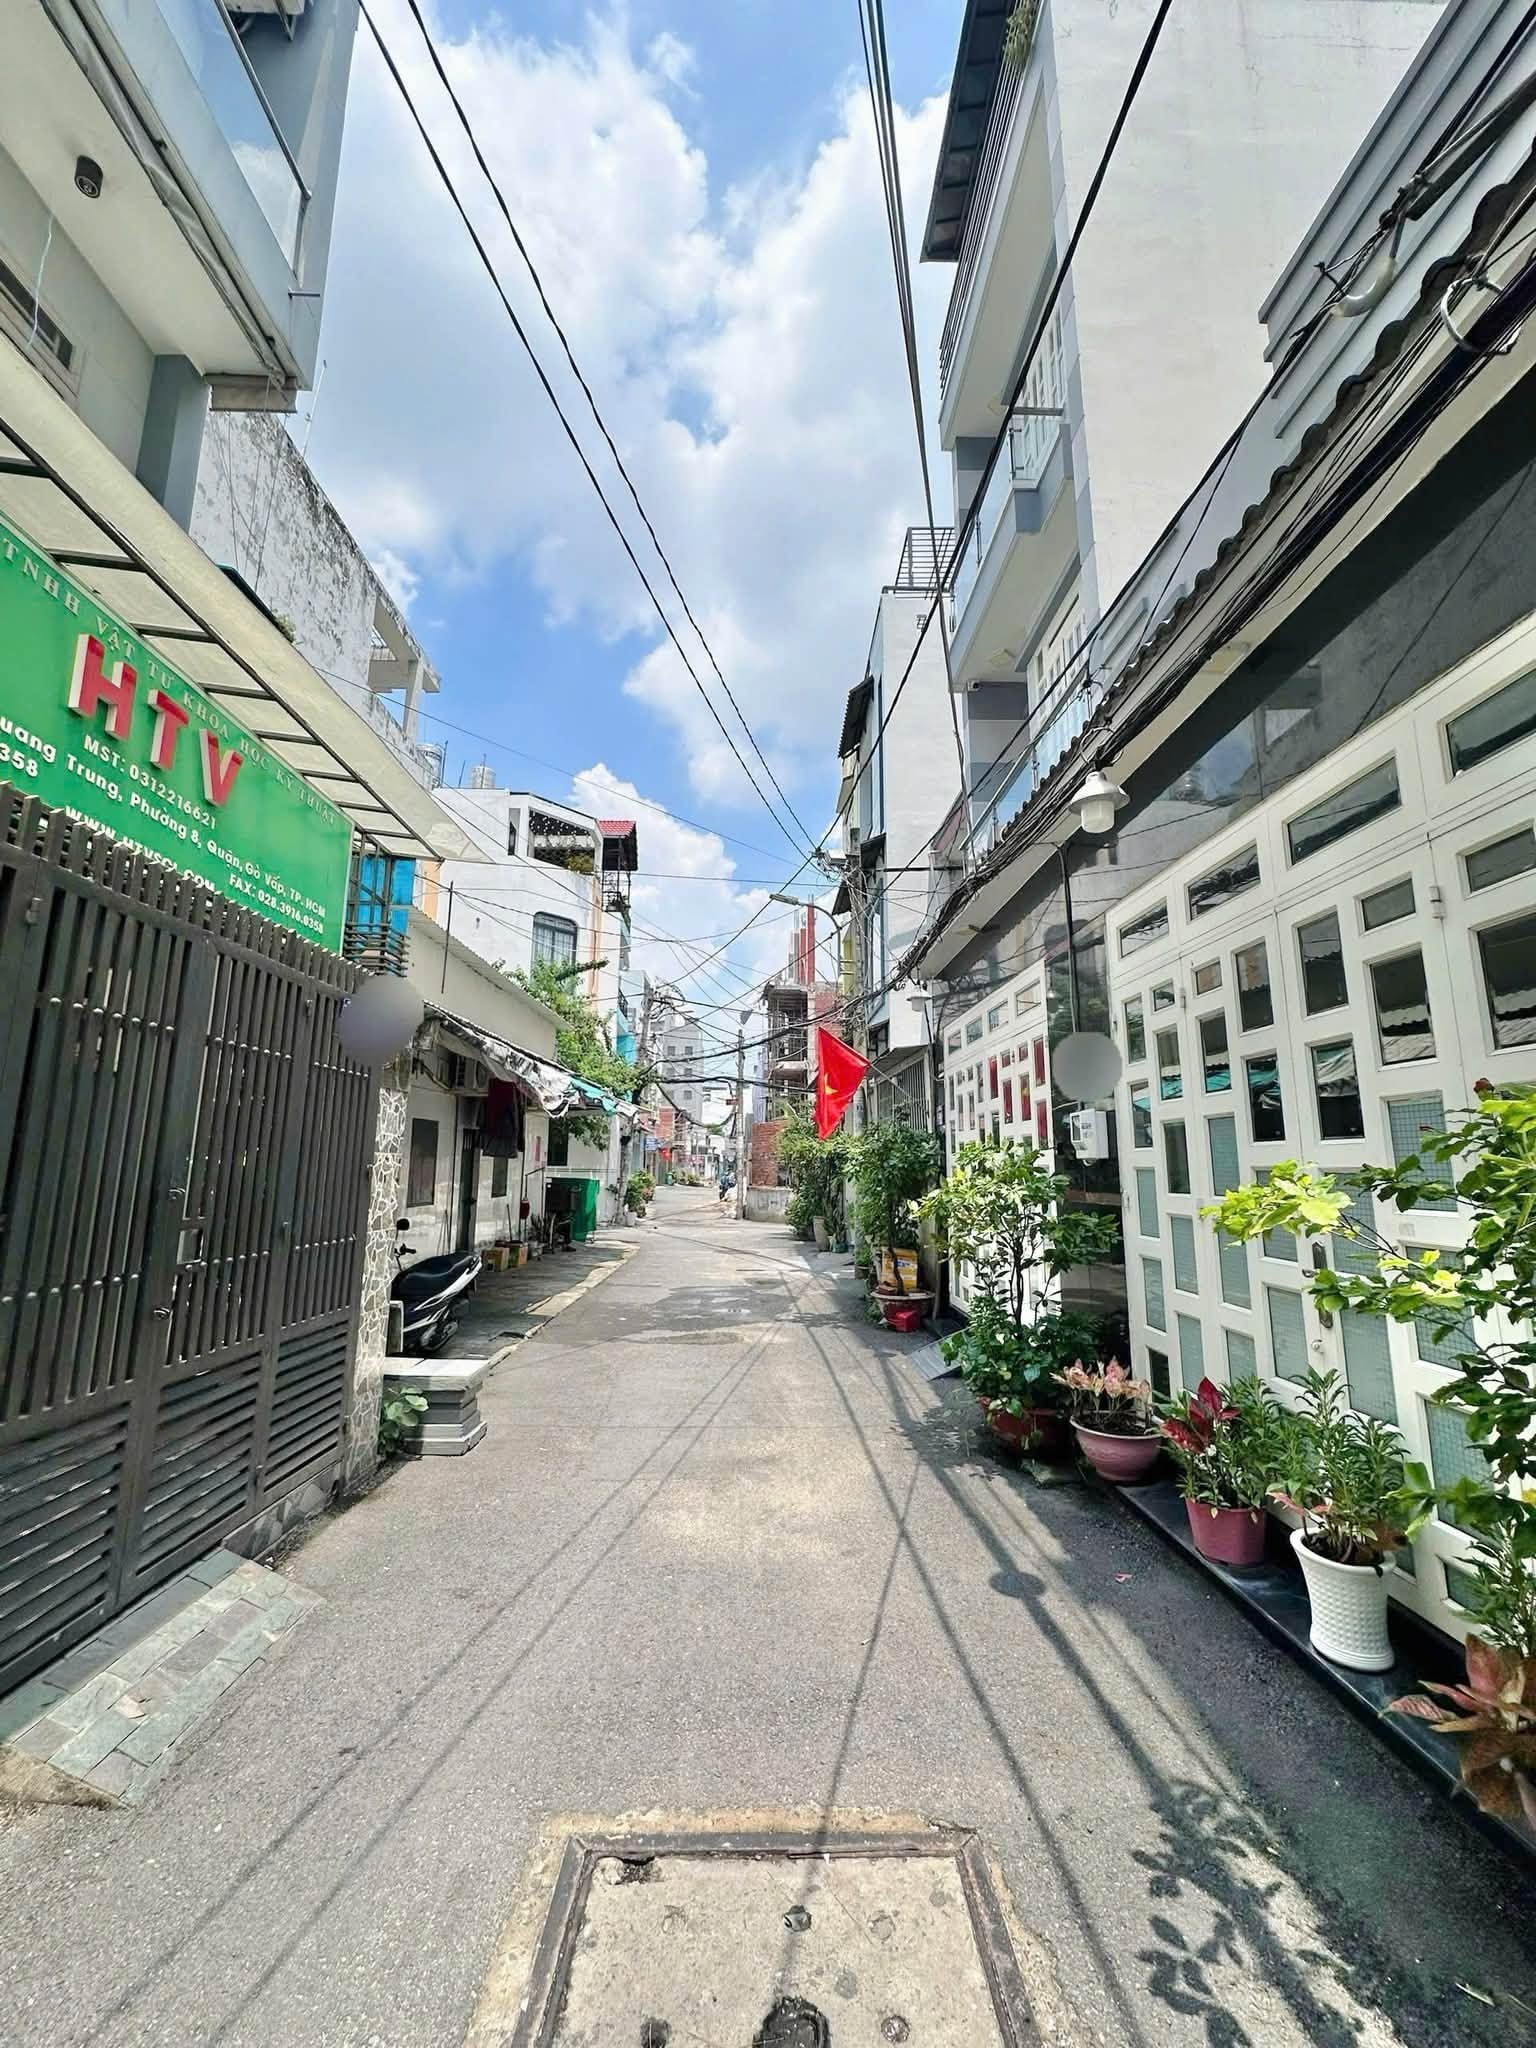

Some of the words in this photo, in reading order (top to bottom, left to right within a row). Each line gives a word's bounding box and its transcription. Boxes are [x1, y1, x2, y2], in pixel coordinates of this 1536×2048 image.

[3, 538, 81, 617] TNHH
[183, 691, 230, 741] KHOA
[0, 716, 57, 763] uang
[66, 753, 123, 802] Trung,
[129, 792, 188, 840] Phường
[190, 829, 202, 849] 8,
[68, 633, 243, 808] HTV
[84, 734, 126, 773] MST:
[129, 764, 217, 830] 0312216621
[229, 873, 257, 898] FAX:
